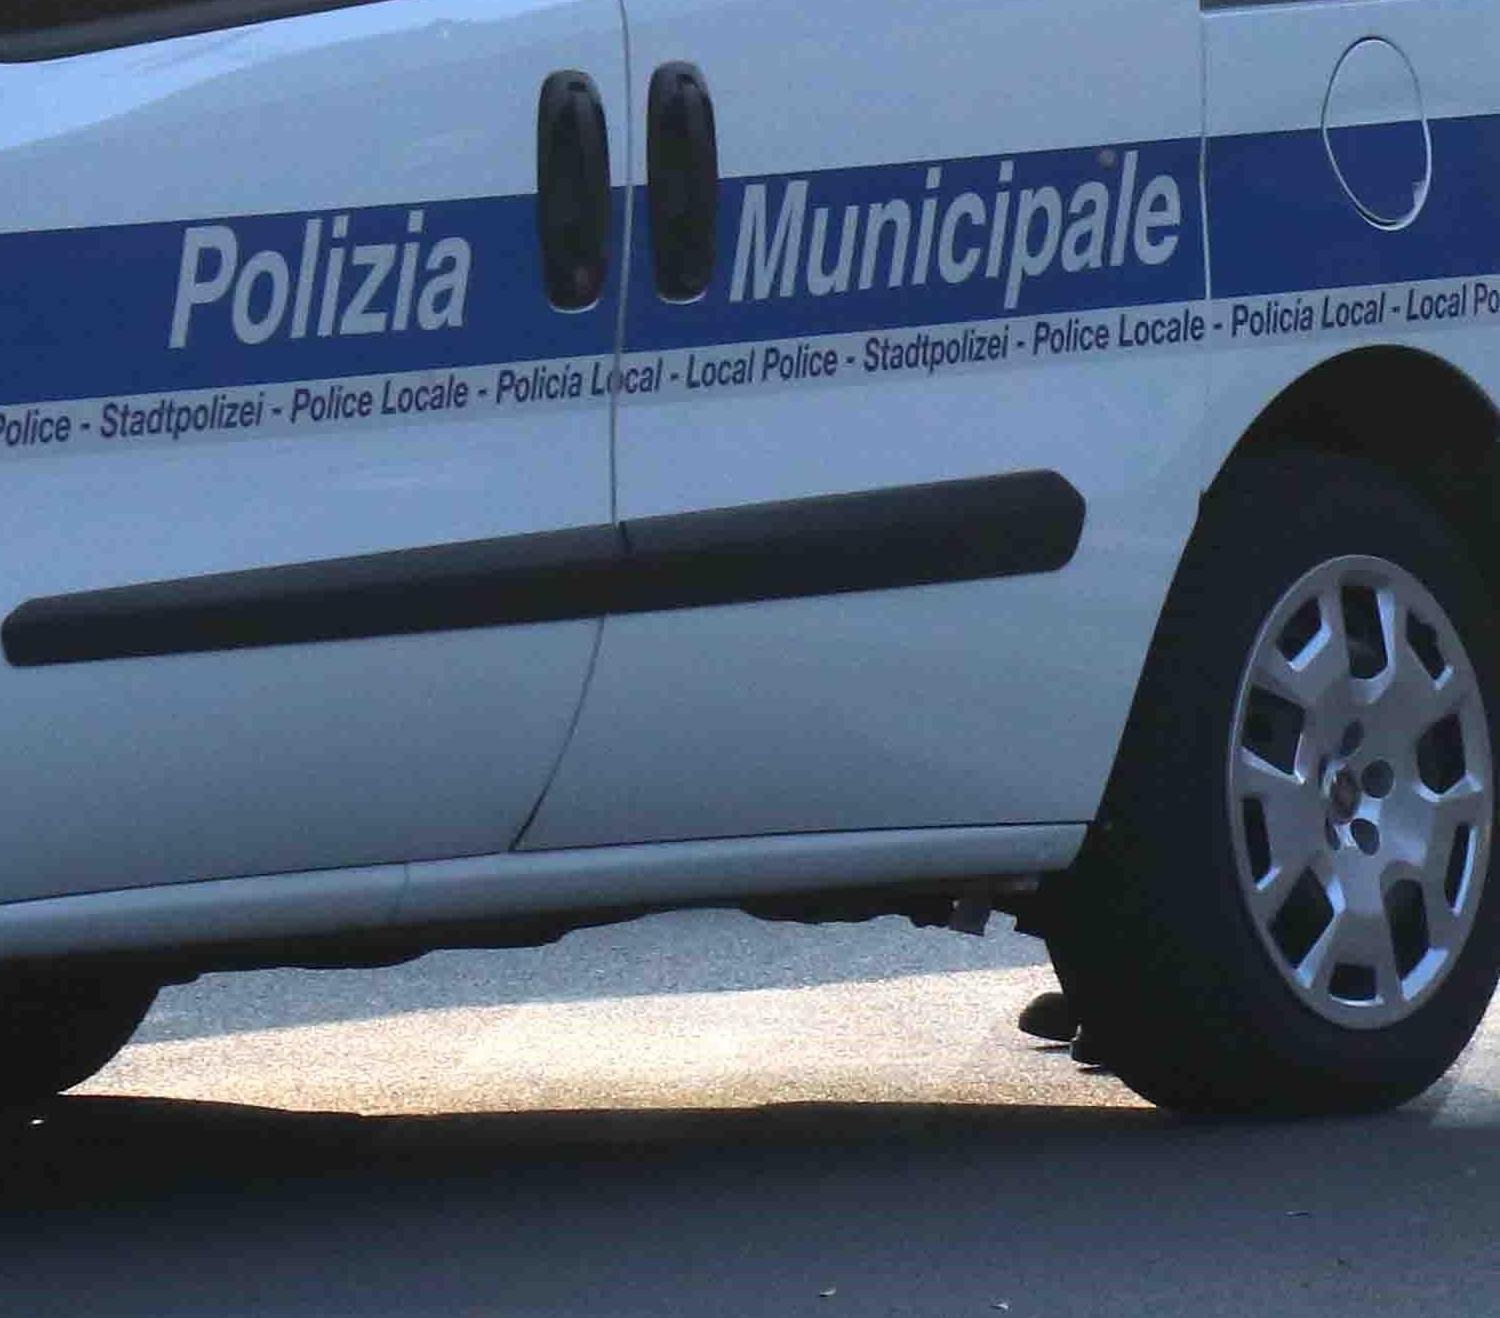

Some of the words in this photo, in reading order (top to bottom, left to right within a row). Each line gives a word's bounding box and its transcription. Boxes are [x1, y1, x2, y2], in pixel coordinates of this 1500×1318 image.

[168, 210, 473, 350] Polizia
[730, 148, 1181, 310] Municipale
[100, 392, 264, 440] Stadtpolizei
[290, 385, 373, 424] Police
[381, 374, 468, 416] Locale
[591, 358, 663, 396] Local
[686, 350, 755, 389] Local
[762, 343, 838, 381] Police
[864, 325, 1010, 375] Stadtpolizei
[1032, 317, 1109, 356] Police
[1118, 308, 1205, 348] Locale
[1321, 291, 1385, 329] Local
[1406, 284, 1467, 322] Local
